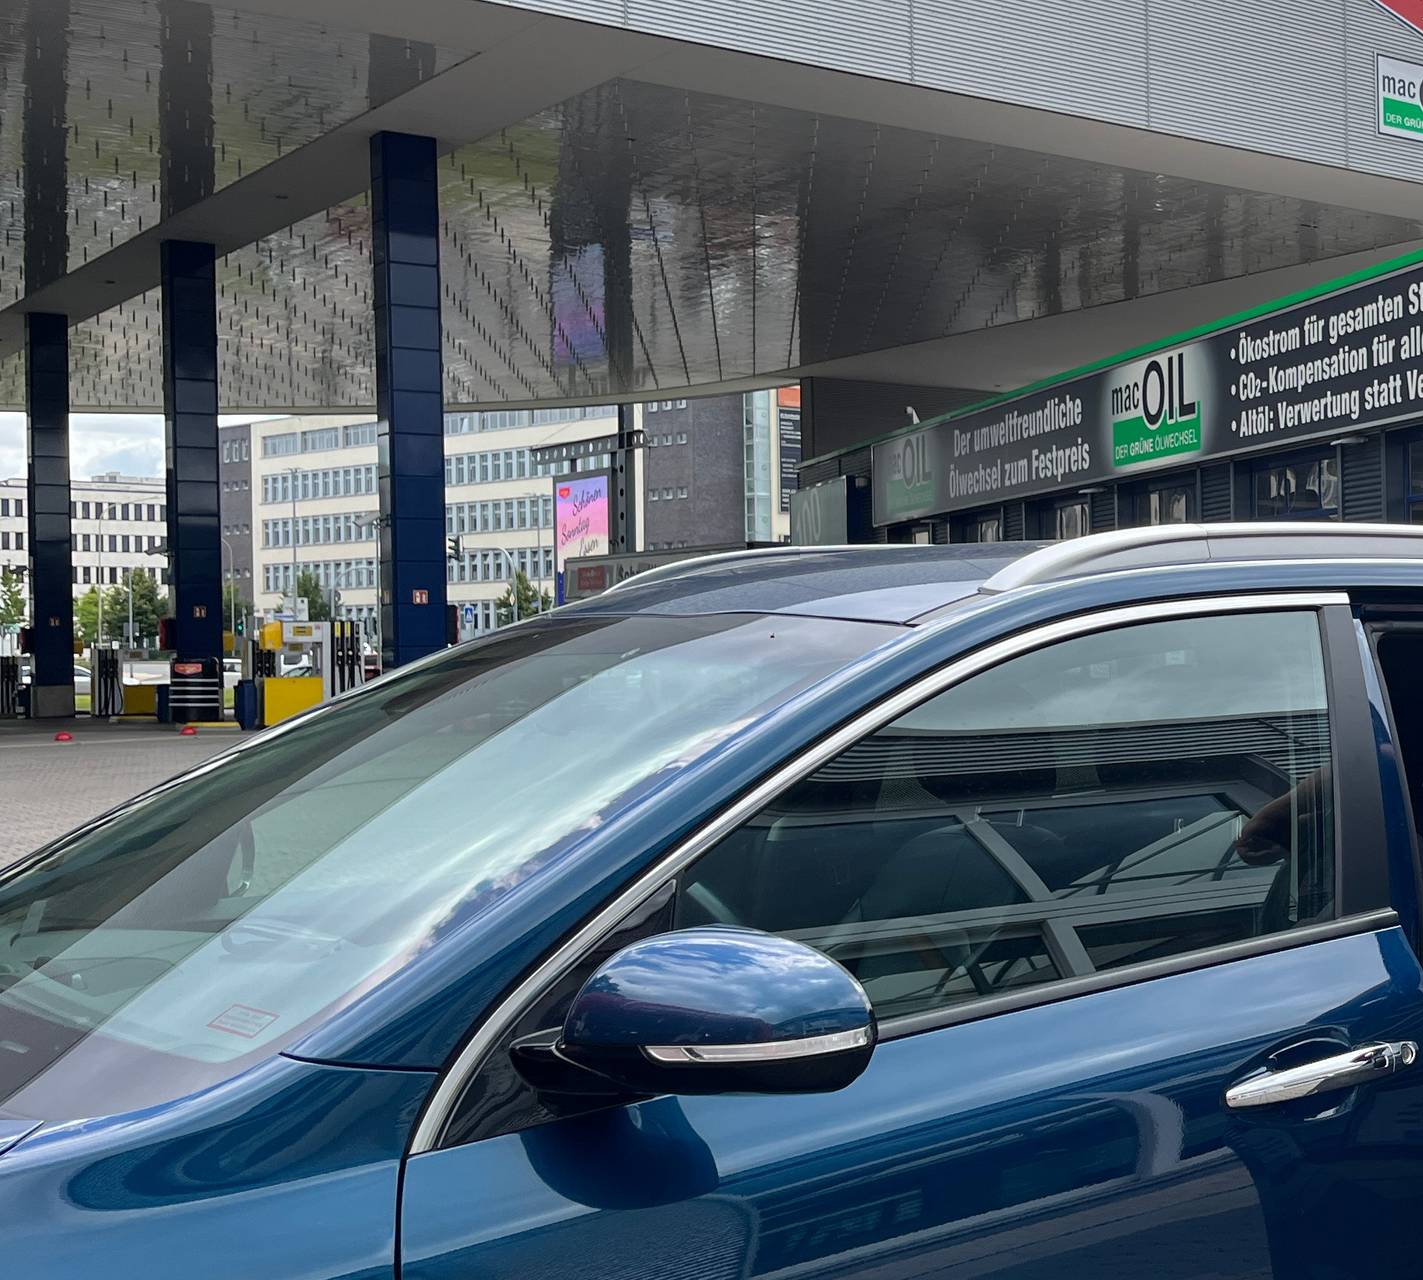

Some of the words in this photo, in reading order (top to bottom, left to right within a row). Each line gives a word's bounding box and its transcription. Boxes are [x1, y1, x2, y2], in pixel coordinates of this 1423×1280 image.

[1386, 113, 1402, 124] DER
[1239, 327, 1300, 364] Ökostrom
[1304, 315, 1325, 346] für
[1329, 294, 1403, 344] gesamten
[1372, 334, 1396, 367] für
[953, 429, 971, 457] Der
[973, 394, 1083, 451] umweltfreundliche
[1240, 406, 1274, 437] Altöl:
[1278, 390, 1360, 420] Verwertung
[1364, 374, 1402, 410] statt
[950, 459, 1001, 498] Ölwechsel
[1004, 457, 1028, 487] zum
[1031, 437, 1090, 482] Festpreis
[1115, 445, 1128, 459] DER
[1129, 437, 1153, 457] GRÜNE
[1155, 429, 1198, 450] ÖLWECHSEL
